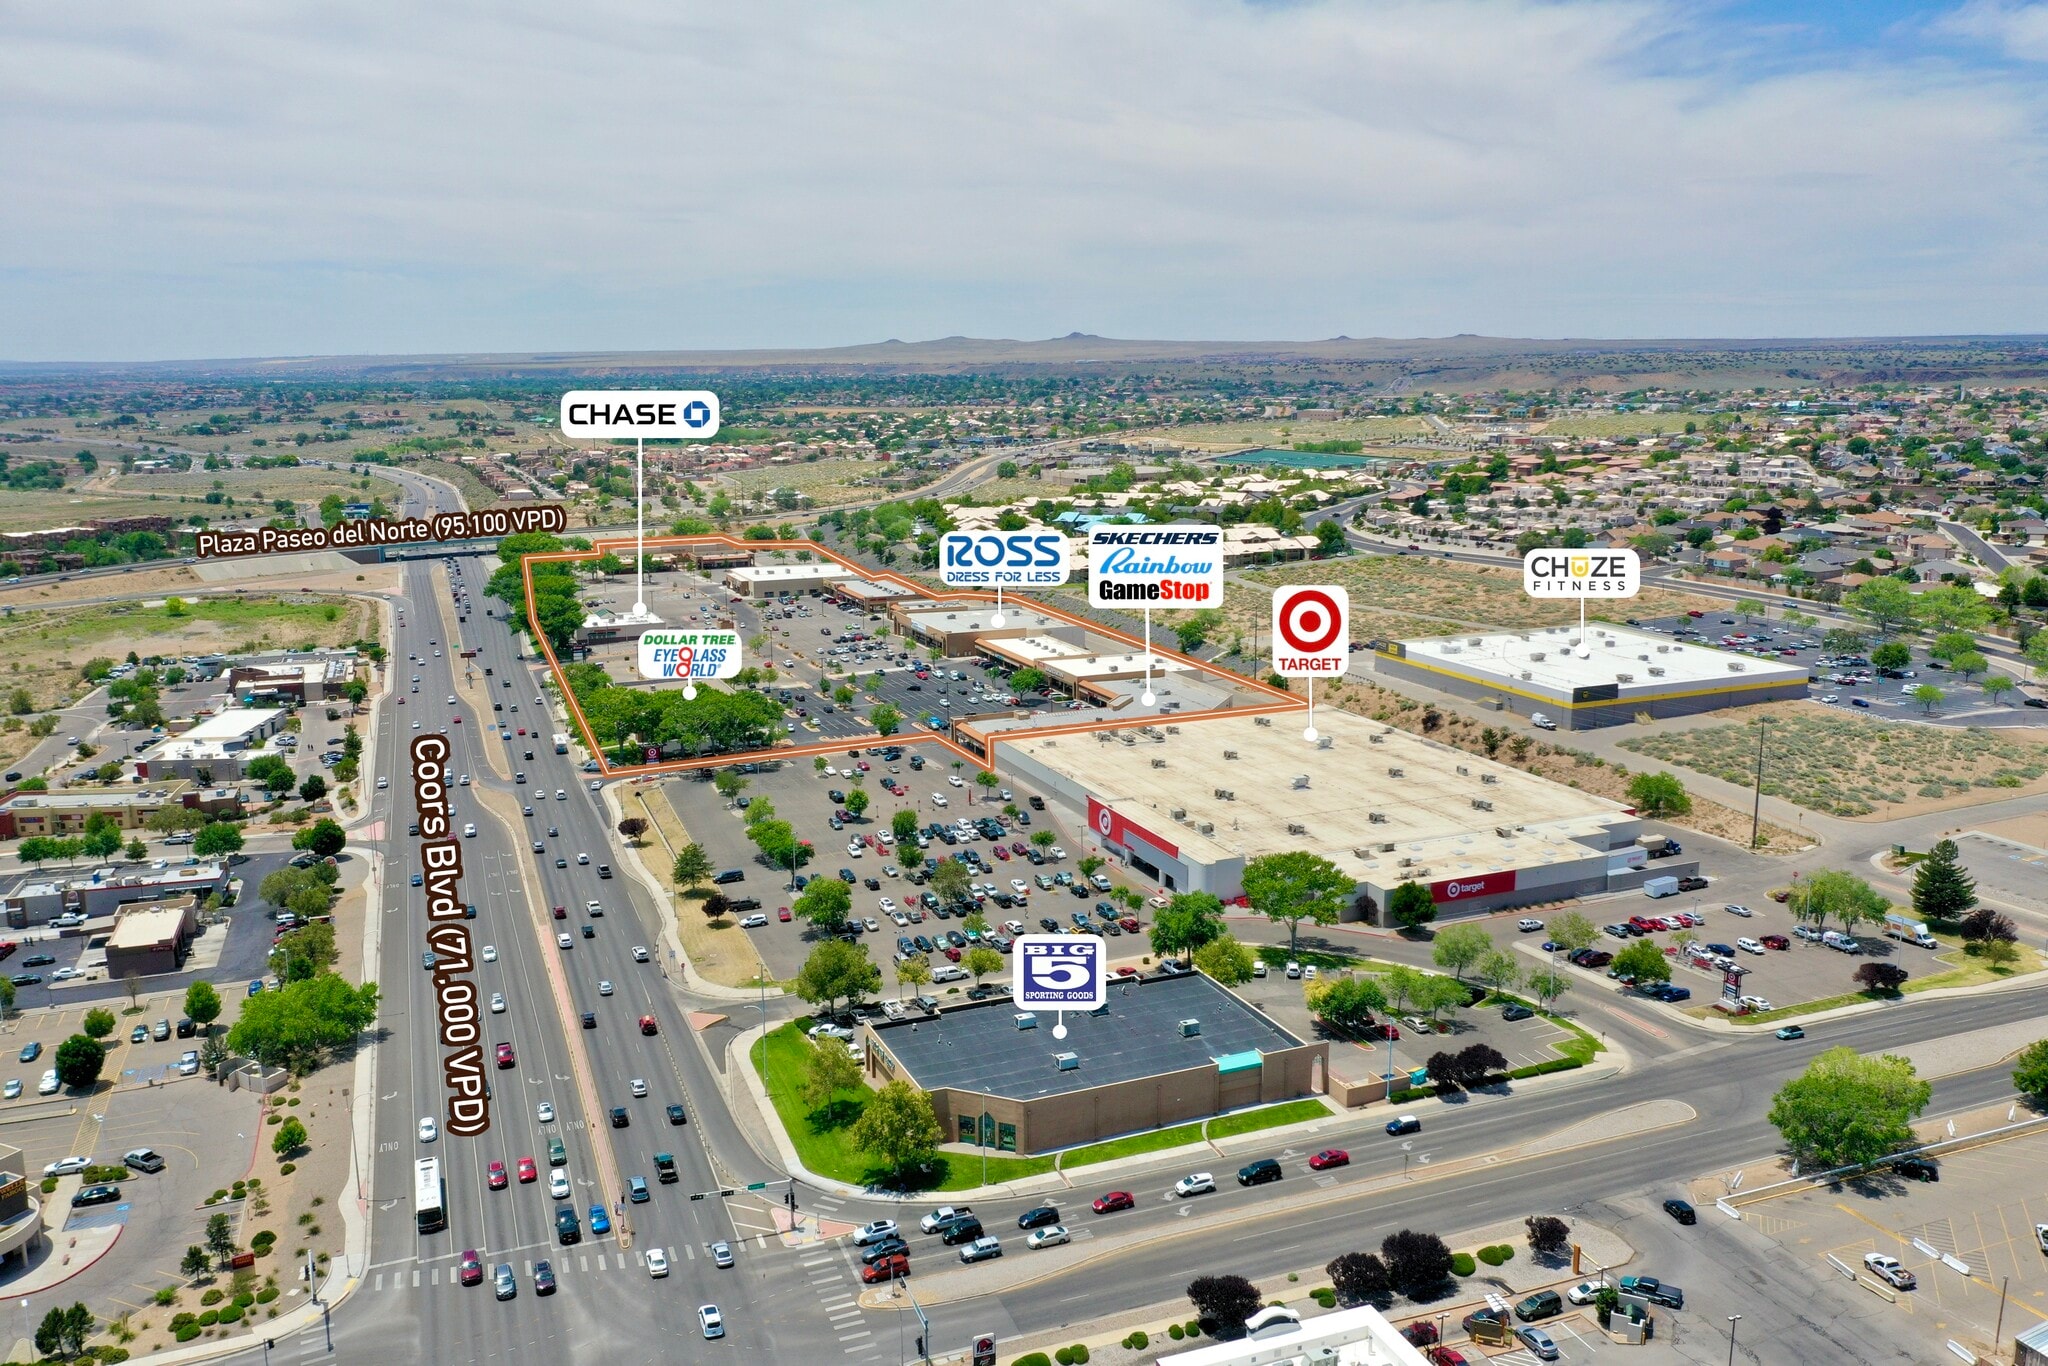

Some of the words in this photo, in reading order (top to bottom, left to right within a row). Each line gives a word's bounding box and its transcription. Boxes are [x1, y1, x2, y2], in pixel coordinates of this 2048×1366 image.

[1461, 881, 1485, 893] target
[537, 1124, 557, 1136] ONLY
[566, 1119, 585, 1132] ONLY
[378, 1141, 399, 1153] ONLY
